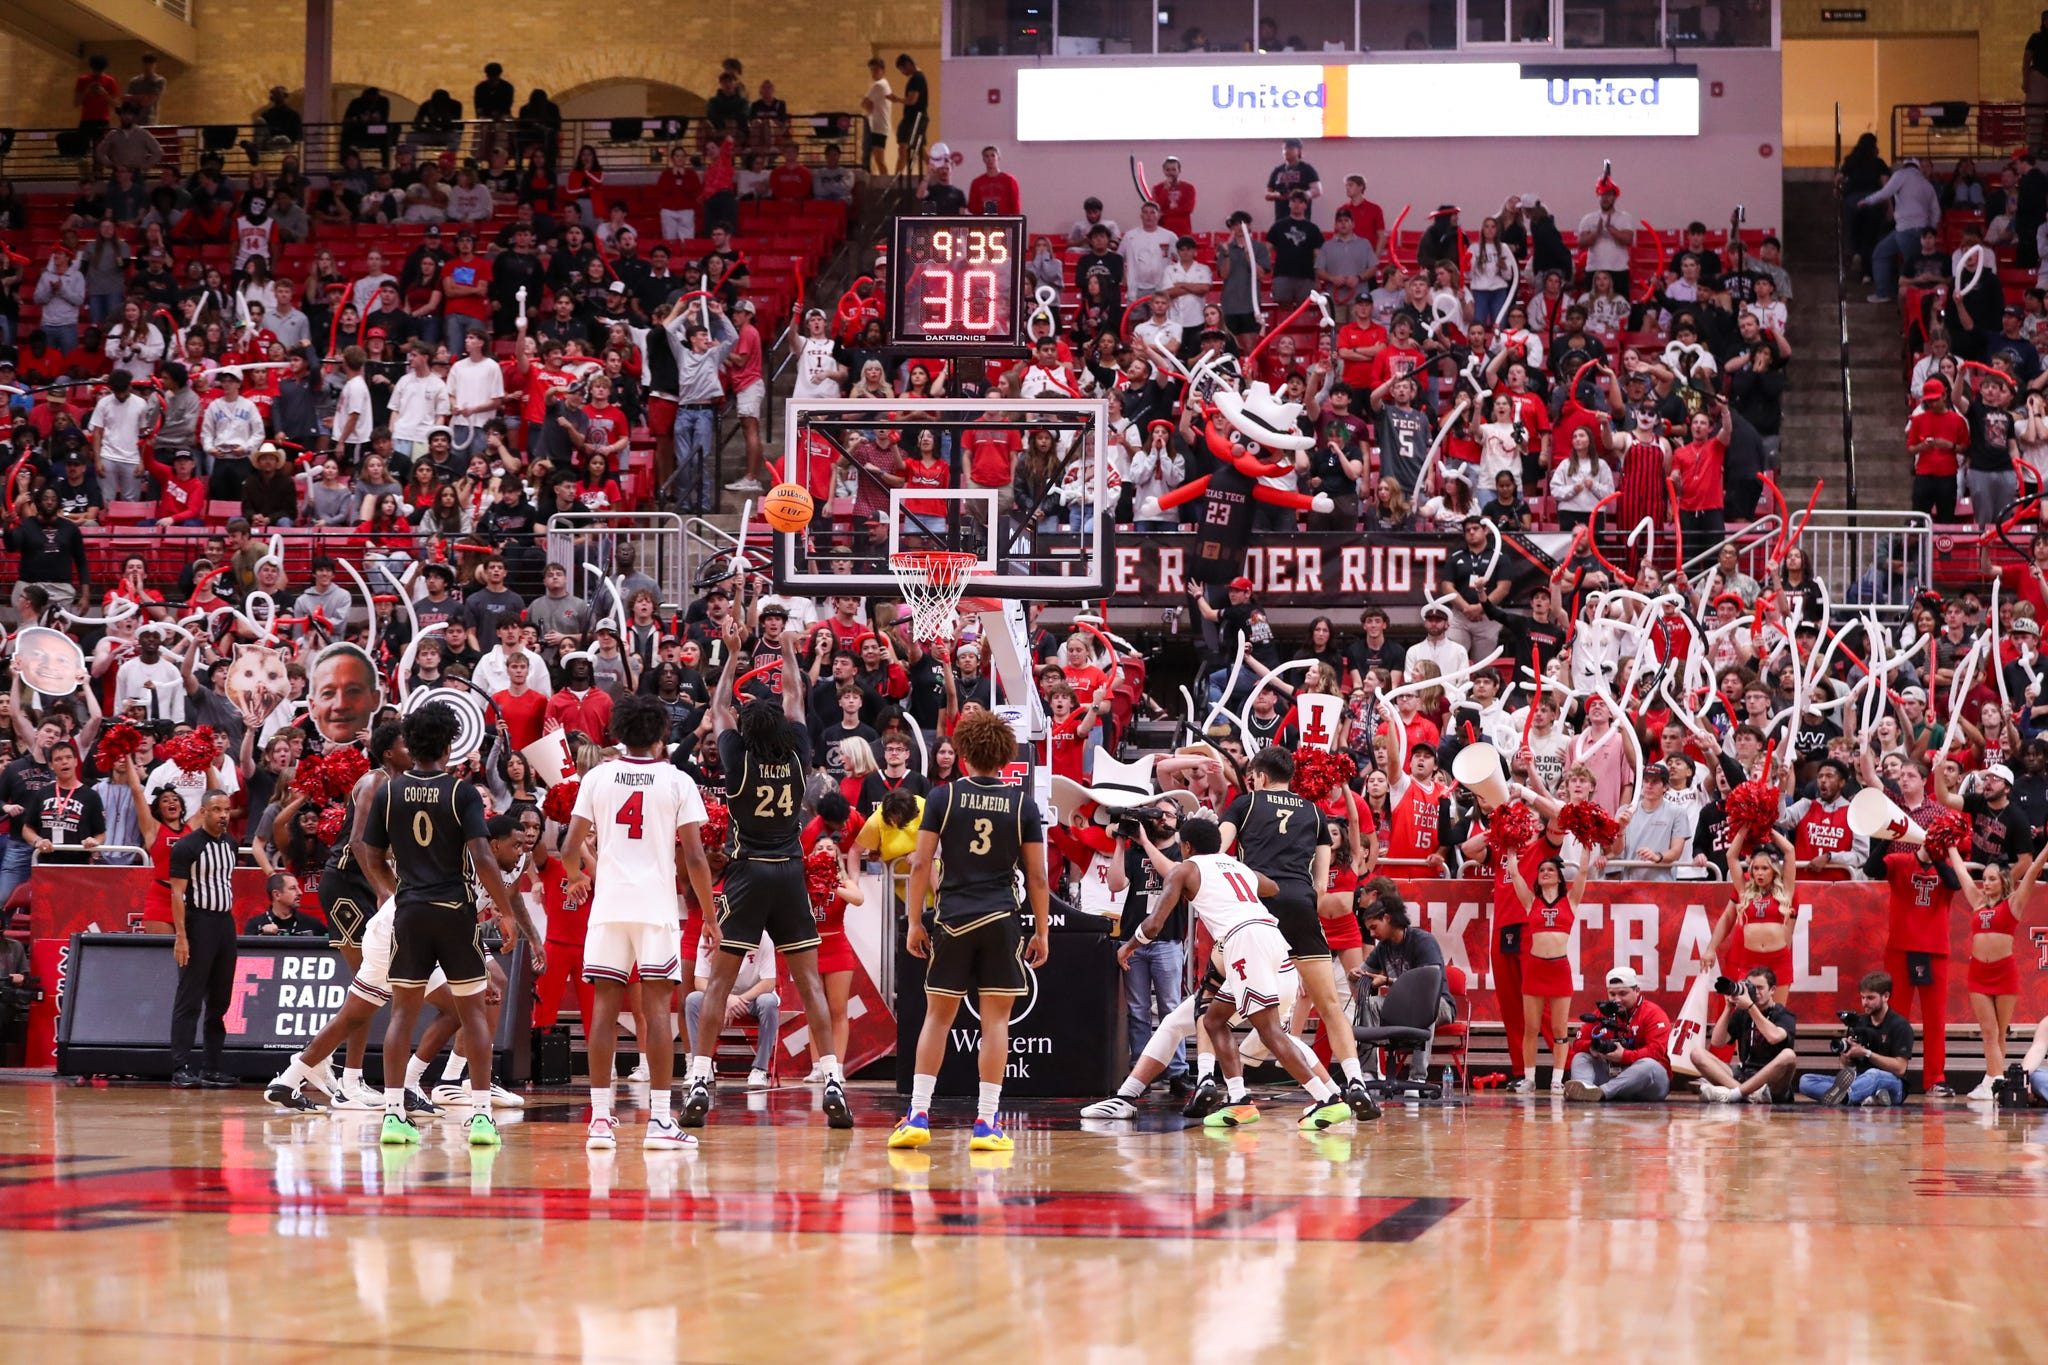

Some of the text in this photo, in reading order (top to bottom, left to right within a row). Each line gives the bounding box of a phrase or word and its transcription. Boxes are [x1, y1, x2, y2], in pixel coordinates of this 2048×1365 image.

[1211, 83, 1326, 109] United
[1546, 78, 1660, 106] United
[932, 231, 1008, 264] 9:35
[921, 270, 996, 330] 30
[925, 334, 987, 342] DAKTRONICS
[1392, 418, 1422, 430] TECH
[1398, 430, 1414, 458] 5
[1225, 491, 1246, 503] TECH
[1205, 501, 1231, 526] 23
[1341, 547, 1447, 592] RIOT
[614, 772, 655, 786] ANDERSON
[758, 763, 791, 779] TALTON
[404, 786, 440, 803] COOPER
[755, 784, 794, 818] 24
[960, 793, 1010, 813] D'ALMEIDA
[1266, 794, 1304, 808] NENADIC
[615, 790, 643, 839] 4
[1275, 808, 1295, 834] 7
[1414, 814, 1439, 829] TECH
[412, 810, 434, 847] 0
[969, 818, 993, 855] 3
[1415, 831, 1432, 849] 15
[1807, 822, 1845, 838] TEXAS
[1808, 834, 1839, 848] TECH
[1222, 872, 1258, 904] 11
[282, 956, 336, 980] RED
[278, 985, 350, 1008] RAID
[275, 1012, 338, 1036] CLU
